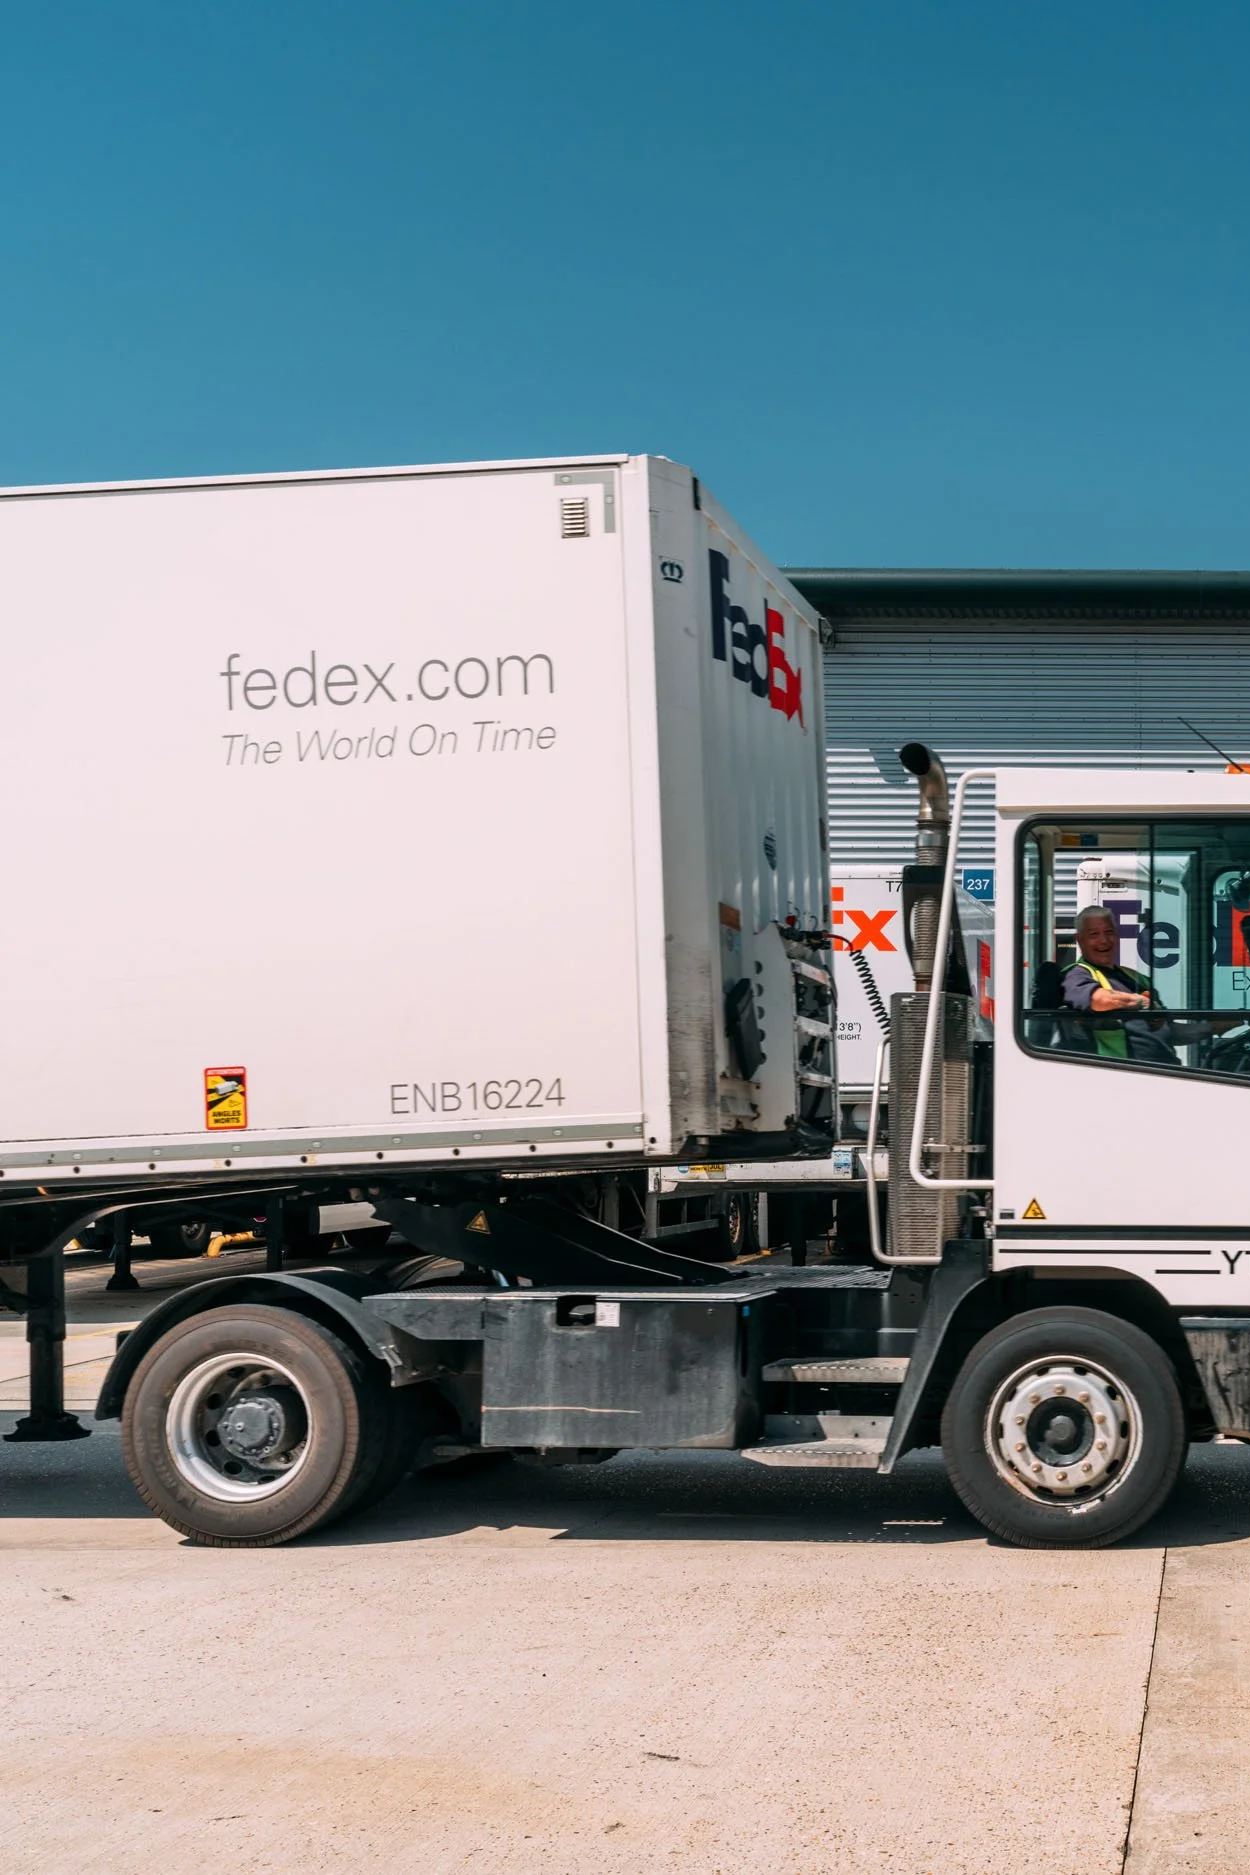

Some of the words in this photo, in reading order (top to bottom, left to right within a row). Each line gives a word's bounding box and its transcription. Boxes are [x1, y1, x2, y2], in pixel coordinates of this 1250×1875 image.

[708, 548, 805, 729] FedEx
[219, 649, 554, 711] fedex.com
[222, 733, 282, 766] The
[296, 725, 398, 762] World
[409, 723, 458, 756] On
[472, 720, 556, 752] Time
[967, 879, 990, 891] 237
[390, 1077, 566, 1114] ENB16224
